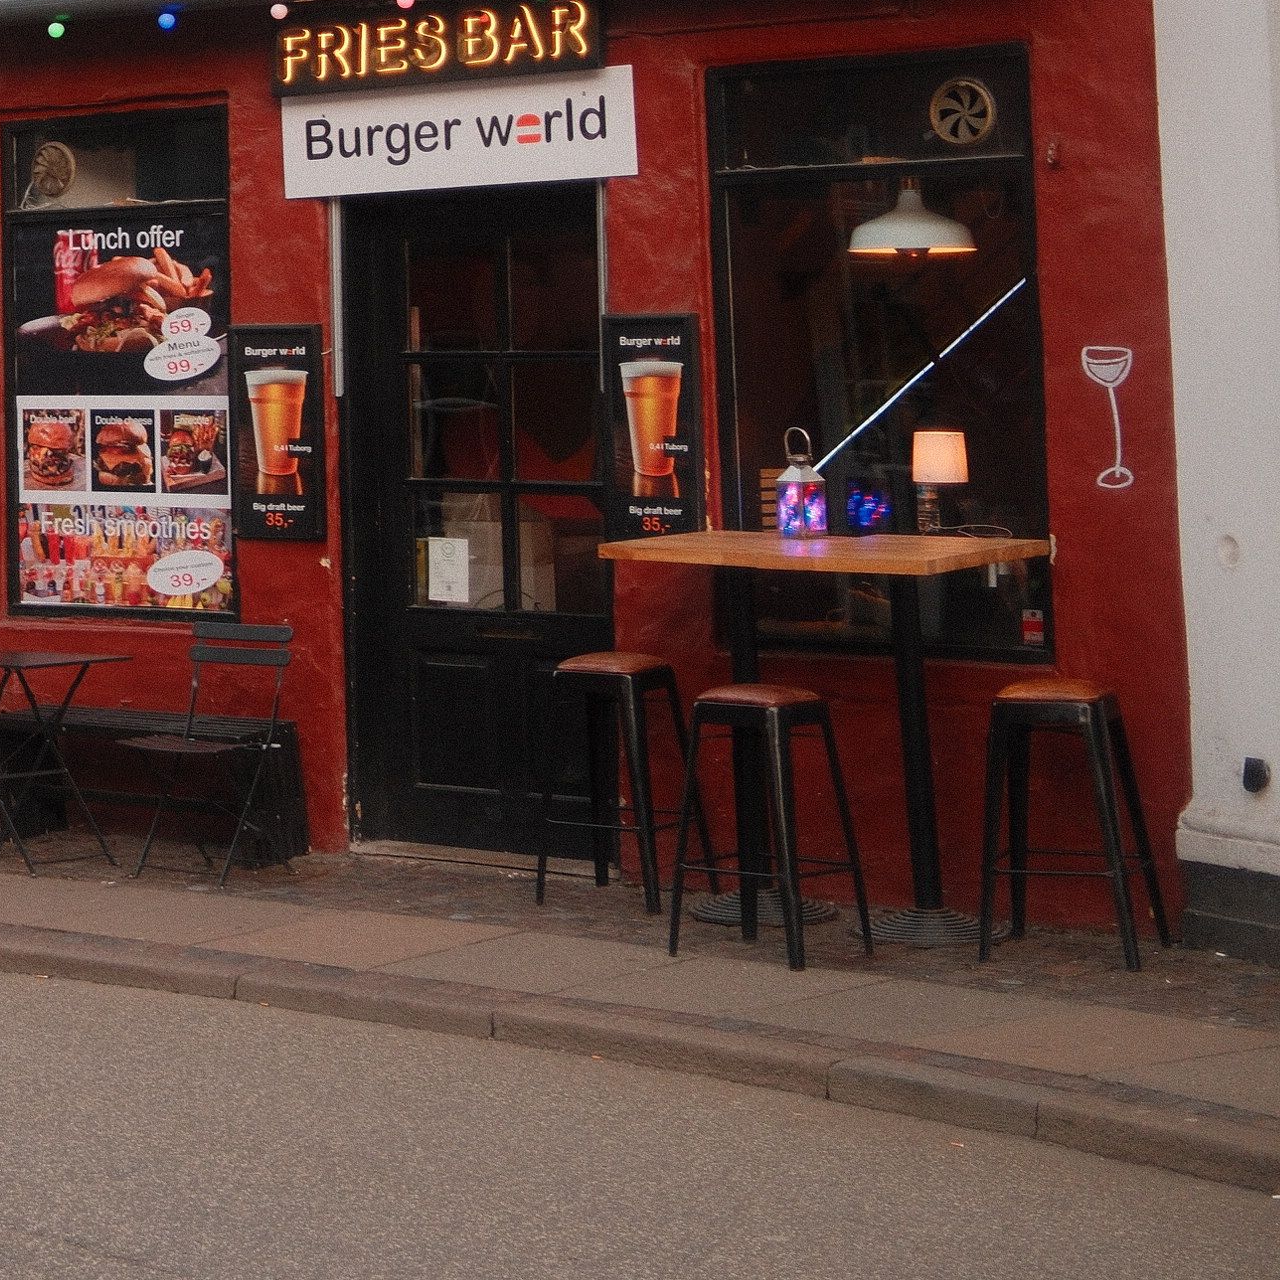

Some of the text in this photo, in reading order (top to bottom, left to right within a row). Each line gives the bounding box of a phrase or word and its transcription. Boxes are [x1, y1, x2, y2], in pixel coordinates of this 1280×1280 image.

[282, 0, 589, 83] FRIES BAR
[305, 117, 461, 166] Burger
[68, 225, 184, 251] Lunch offer
[168, 319, 206, 335] 59,-
[167, 338, 200, 352] Menu
[619, 336, 652, 348] Burger
[244, 346, 278, 358] Burger
[167, 359, 204, 375] 99,-
[30, 414, 58, 424] Double
[95, 415, 153, 426] Double cheese
[289, 444, 312, 454] Tuborg
[664, 442, 689, 452] Tuborg
[253, 502, 306, 512] Big draft beer
[629, 505, 683, 516] Big draft beer
[41, 511, 212, 540] Fresh smoothies
[265, 513, 294, 528] 35,-
[642, 517, 671, 532] 35,-
[170, 573, 207, 589] 39,-
